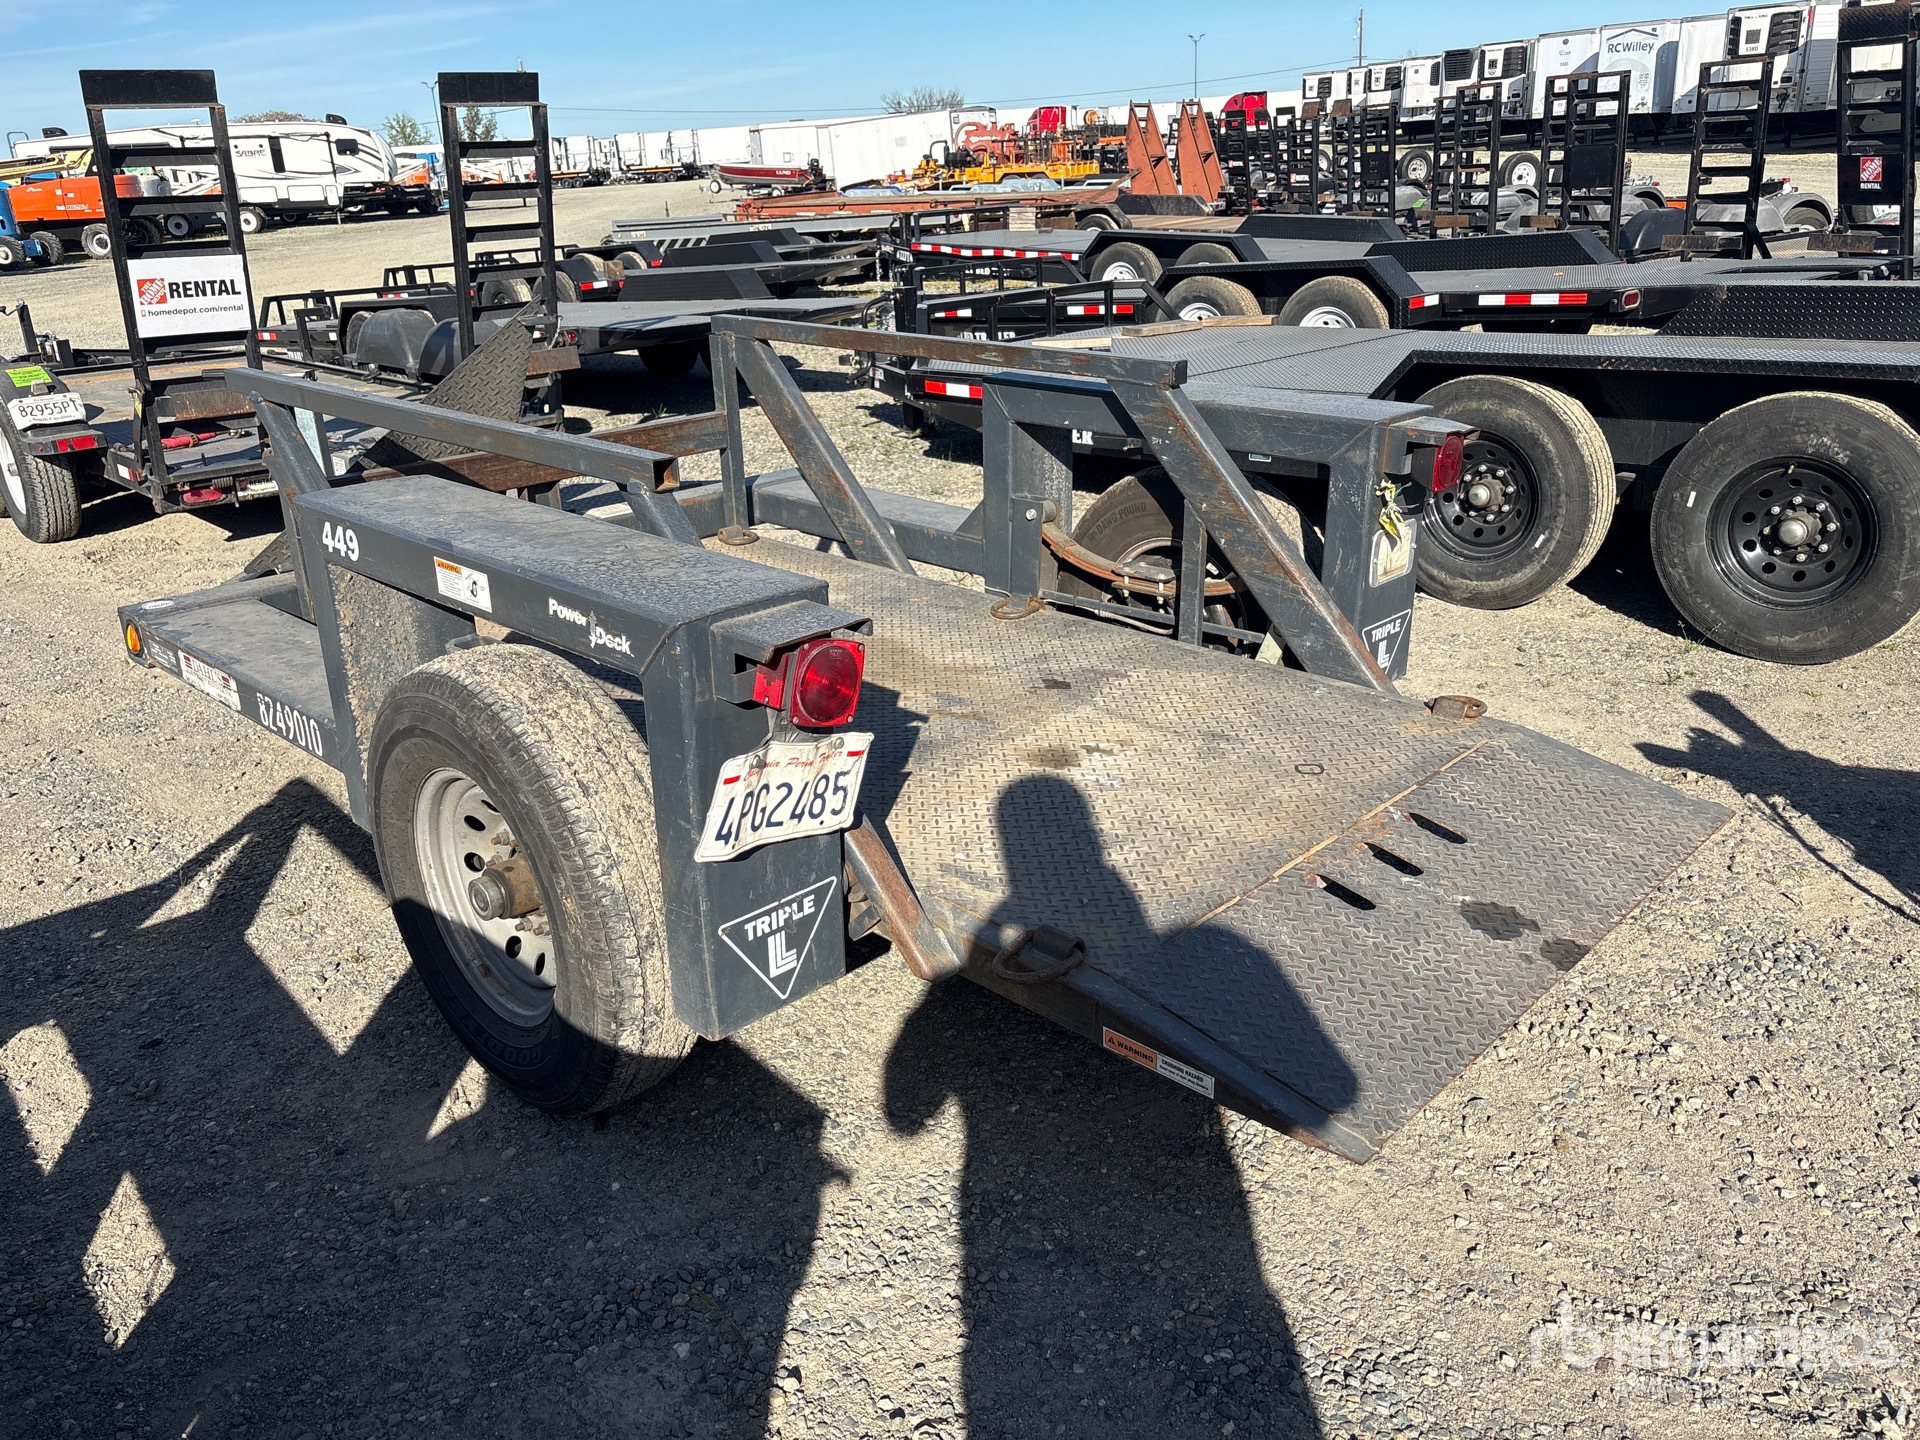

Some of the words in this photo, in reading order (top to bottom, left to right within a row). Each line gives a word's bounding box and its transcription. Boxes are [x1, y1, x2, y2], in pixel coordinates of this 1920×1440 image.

[1860, 157, 1882, 181] HOME
[1863, 160, 1872, 169] THE
[1868, 166, 1882, 180] DEPOT
[1860, 182, 1881, 190] RENTAL
[139, 278, 165, 305] HOME
[168, 279, 241, 299] RENTAL
[148, 304, 244, 317] homedepot.com/rental
[18, 400, 79, 418] 82955PT
[1096, 512, 1118, 536] DAWG
[1119, 501, 1148, 520] POUND
[322, 521, 360, 562] 449
[548, 596, 587, 627] Power
[1371, 618, 1402, 643] TRIPLE
[256, 692, 323, 757] 8249010
[715, 769, 850, 846] 4PG2485
[744, 894, 816, 942] TRIPLE
[1117, 1040, 1154, 1064] WARNING
